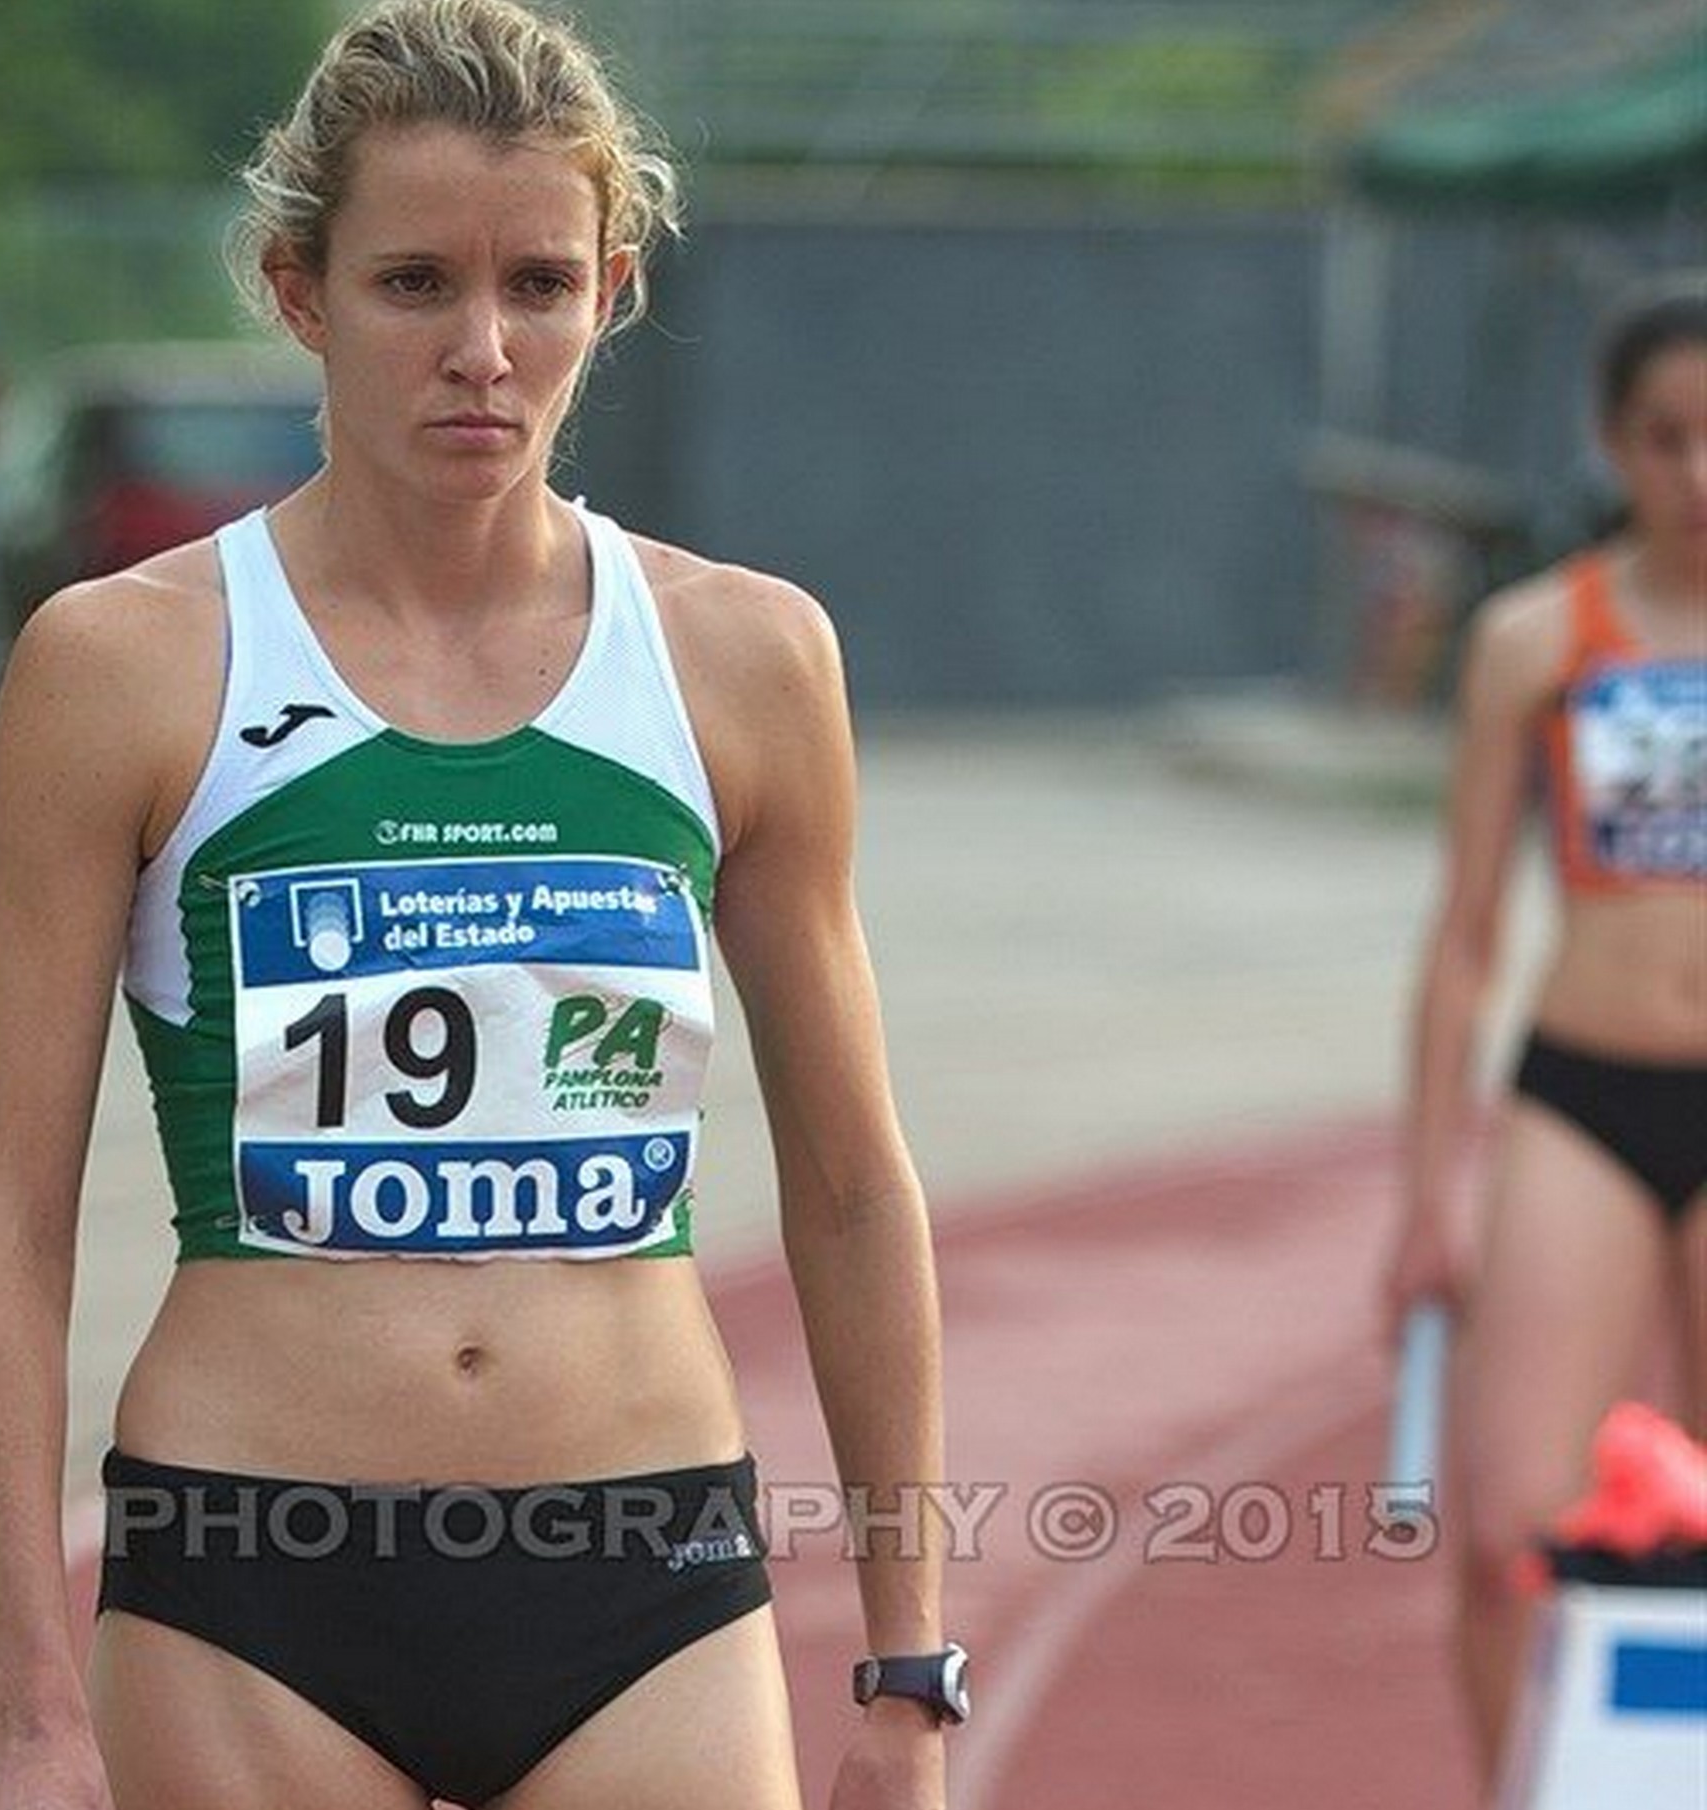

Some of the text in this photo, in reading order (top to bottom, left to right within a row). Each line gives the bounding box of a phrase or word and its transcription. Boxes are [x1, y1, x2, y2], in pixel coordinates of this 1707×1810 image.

[380, 888, 499, 917] Loterías
[505, 892, 524, 920] y
[383, 922, 536, 950] del Estado
[544, 995, 664, 1069] PA
[284, 985, 478, 1130] 19
[543, 1068, 663, 1090] PAMPLONA
